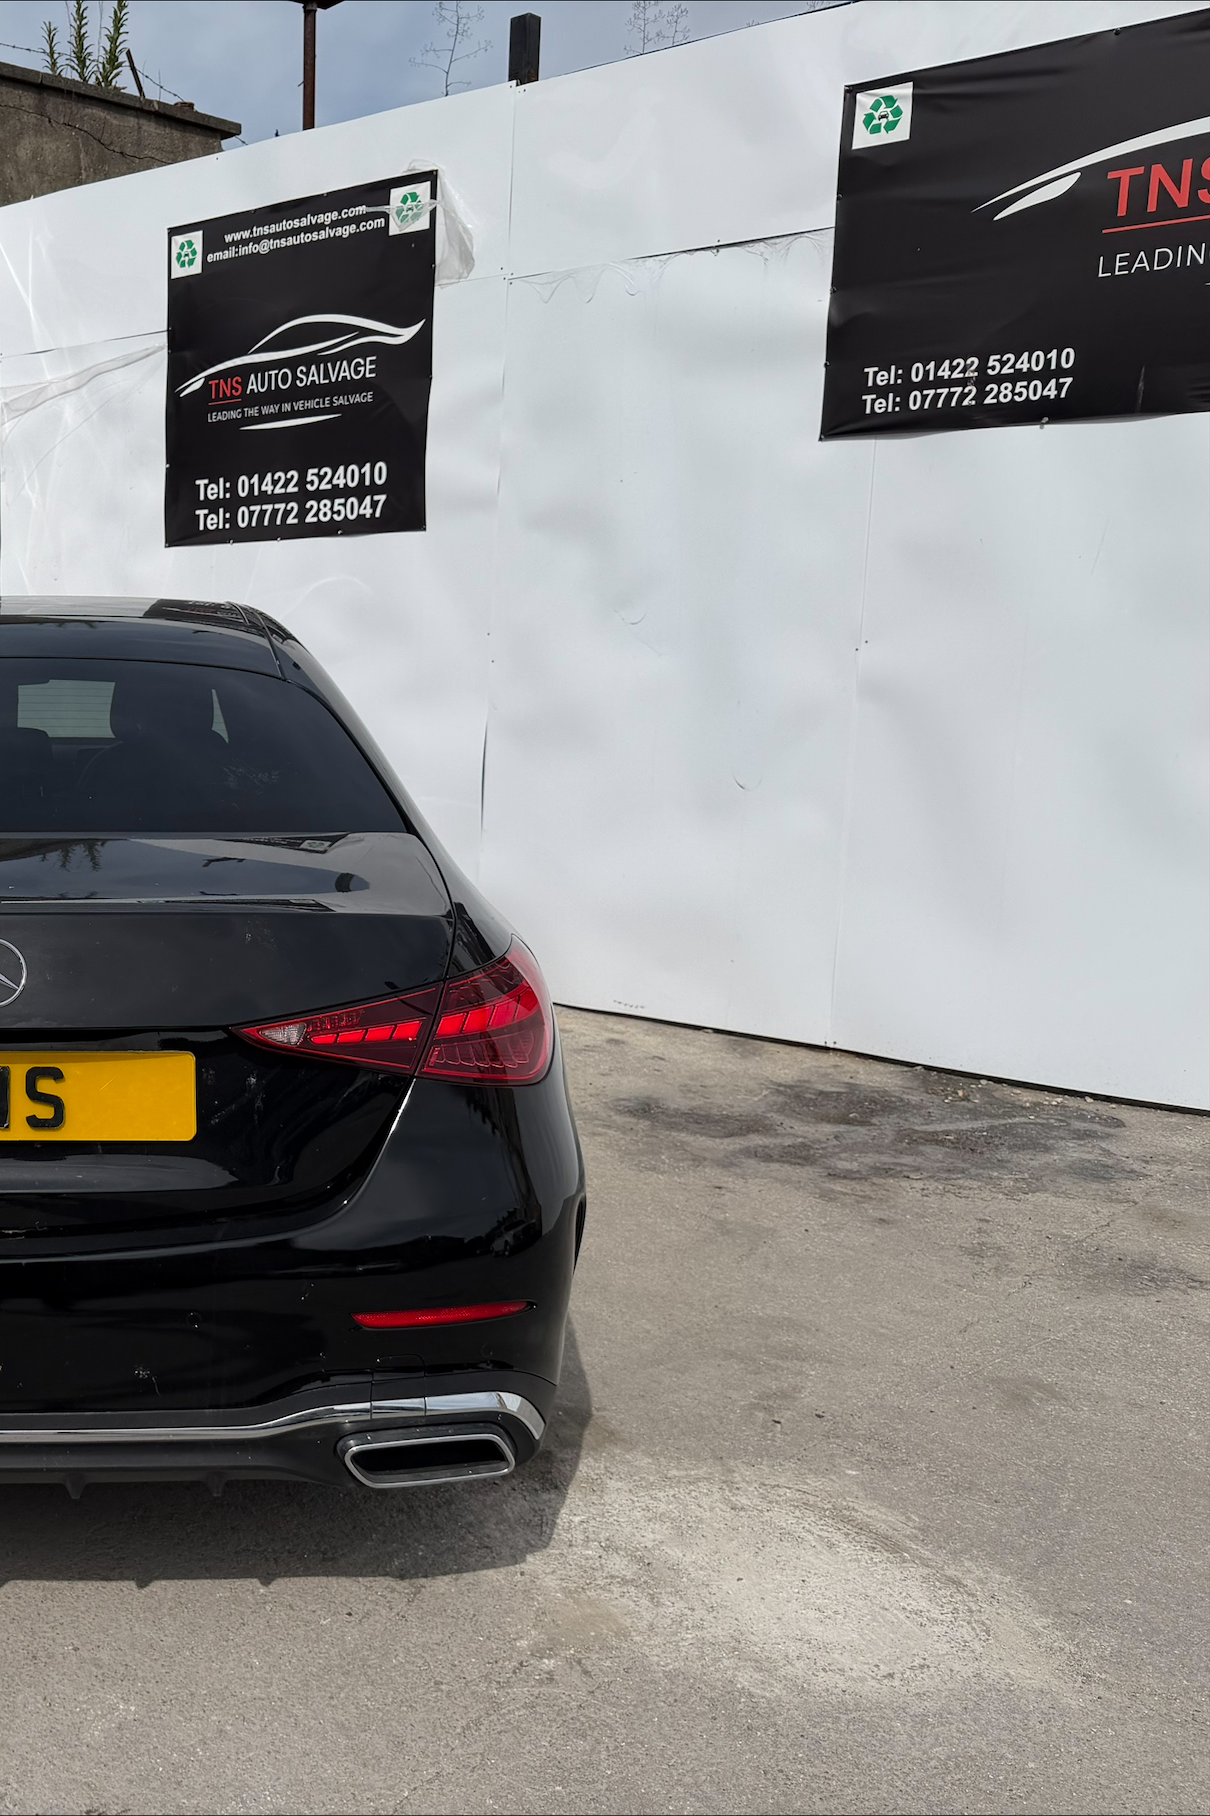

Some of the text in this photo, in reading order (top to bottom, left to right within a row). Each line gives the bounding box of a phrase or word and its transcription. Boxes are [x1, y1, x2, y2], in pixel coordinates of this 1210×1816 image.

[207, 218, 385, 262] email:info@tnsautosalvage.com
[225, 205, 367, 242] www.tnsautosalvage.com
[1099, 243, 1210, 277] LEADIN
[209, 356, 376, 400] TNS AUTO SALVAGE
[864, 348, 1074, 386] Tel: 01422 524010
[208, 392, 373, 422] LEADING THE WAY IN VEHICLE SALVAGE
[862, 377, 1073, 414] Tel: 07772 285047
[196, 462, 387, 500] Tel: 01422 524010
[195, 495, 386, 530] Tel: 07772 285047
